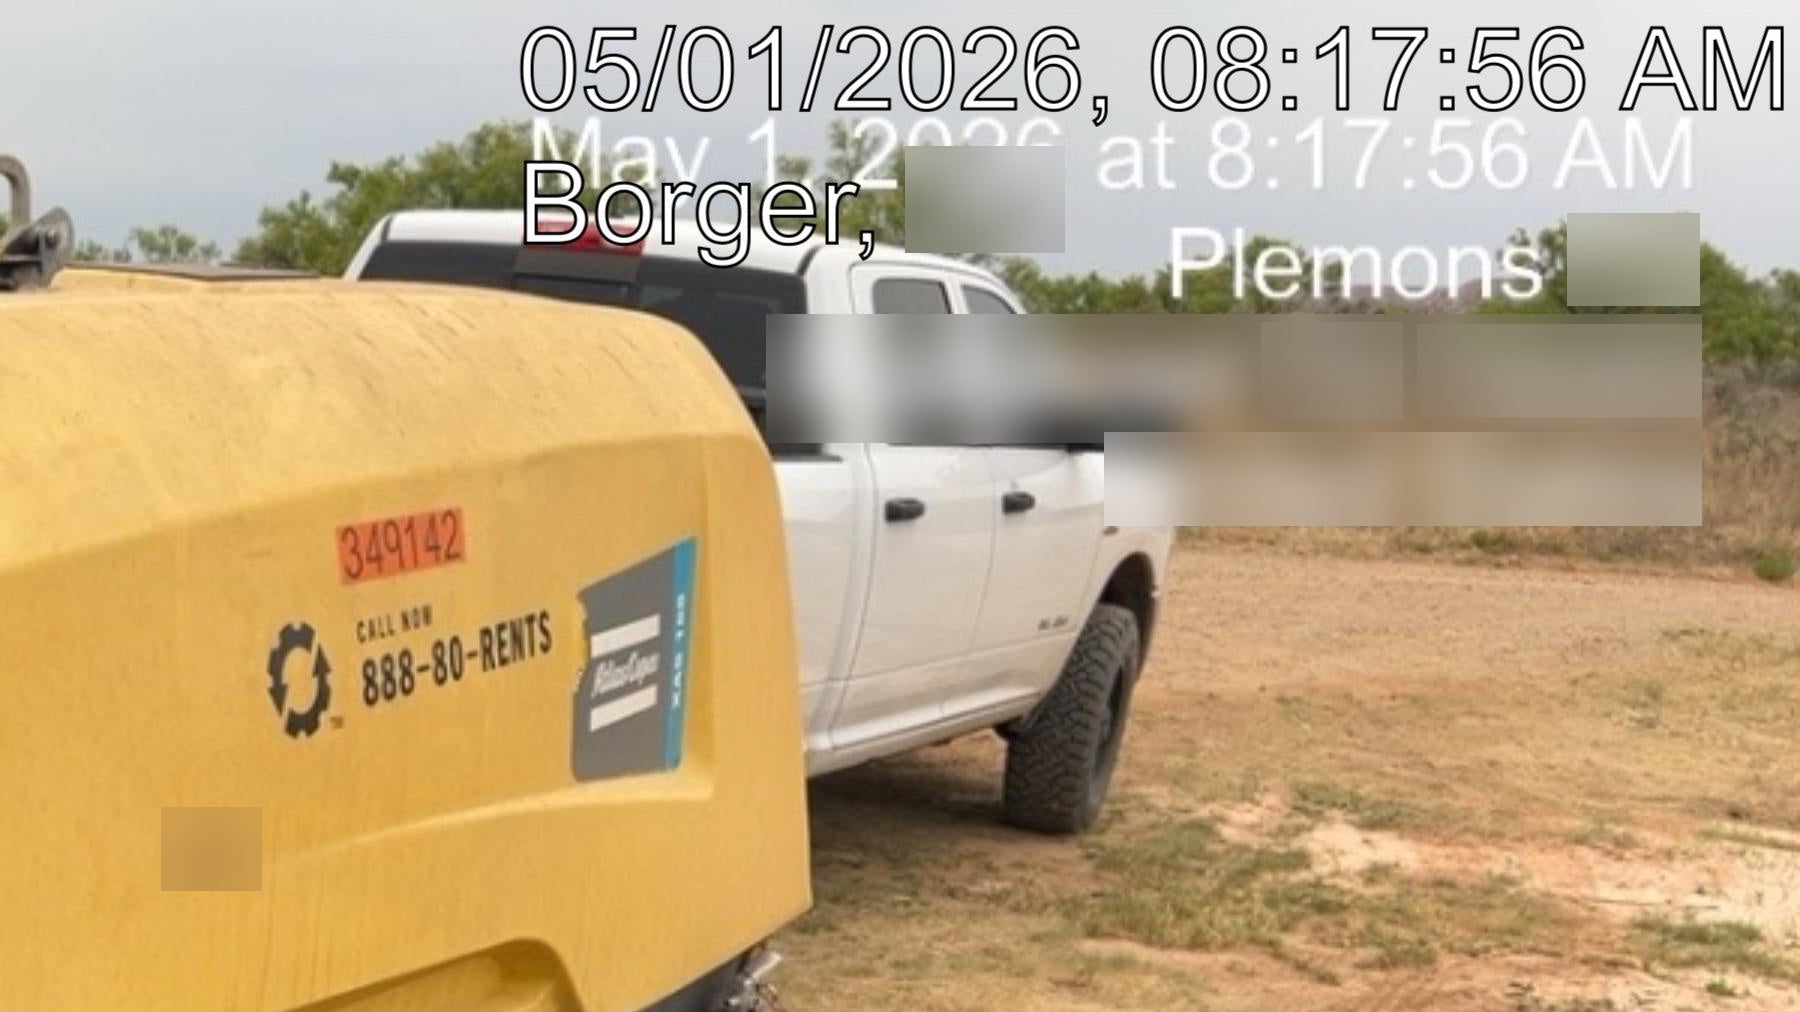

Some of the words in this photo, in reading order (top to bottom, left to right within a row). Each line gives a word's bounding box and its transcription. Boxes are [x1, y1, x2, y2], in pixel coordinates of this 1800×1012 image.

[340, 508, 463, 579] 349142
[356, 613, 396, 643] CALL
[401, 604, 433, 631] NOW
[361, 611, 553, 706] 888-80-RENTS
